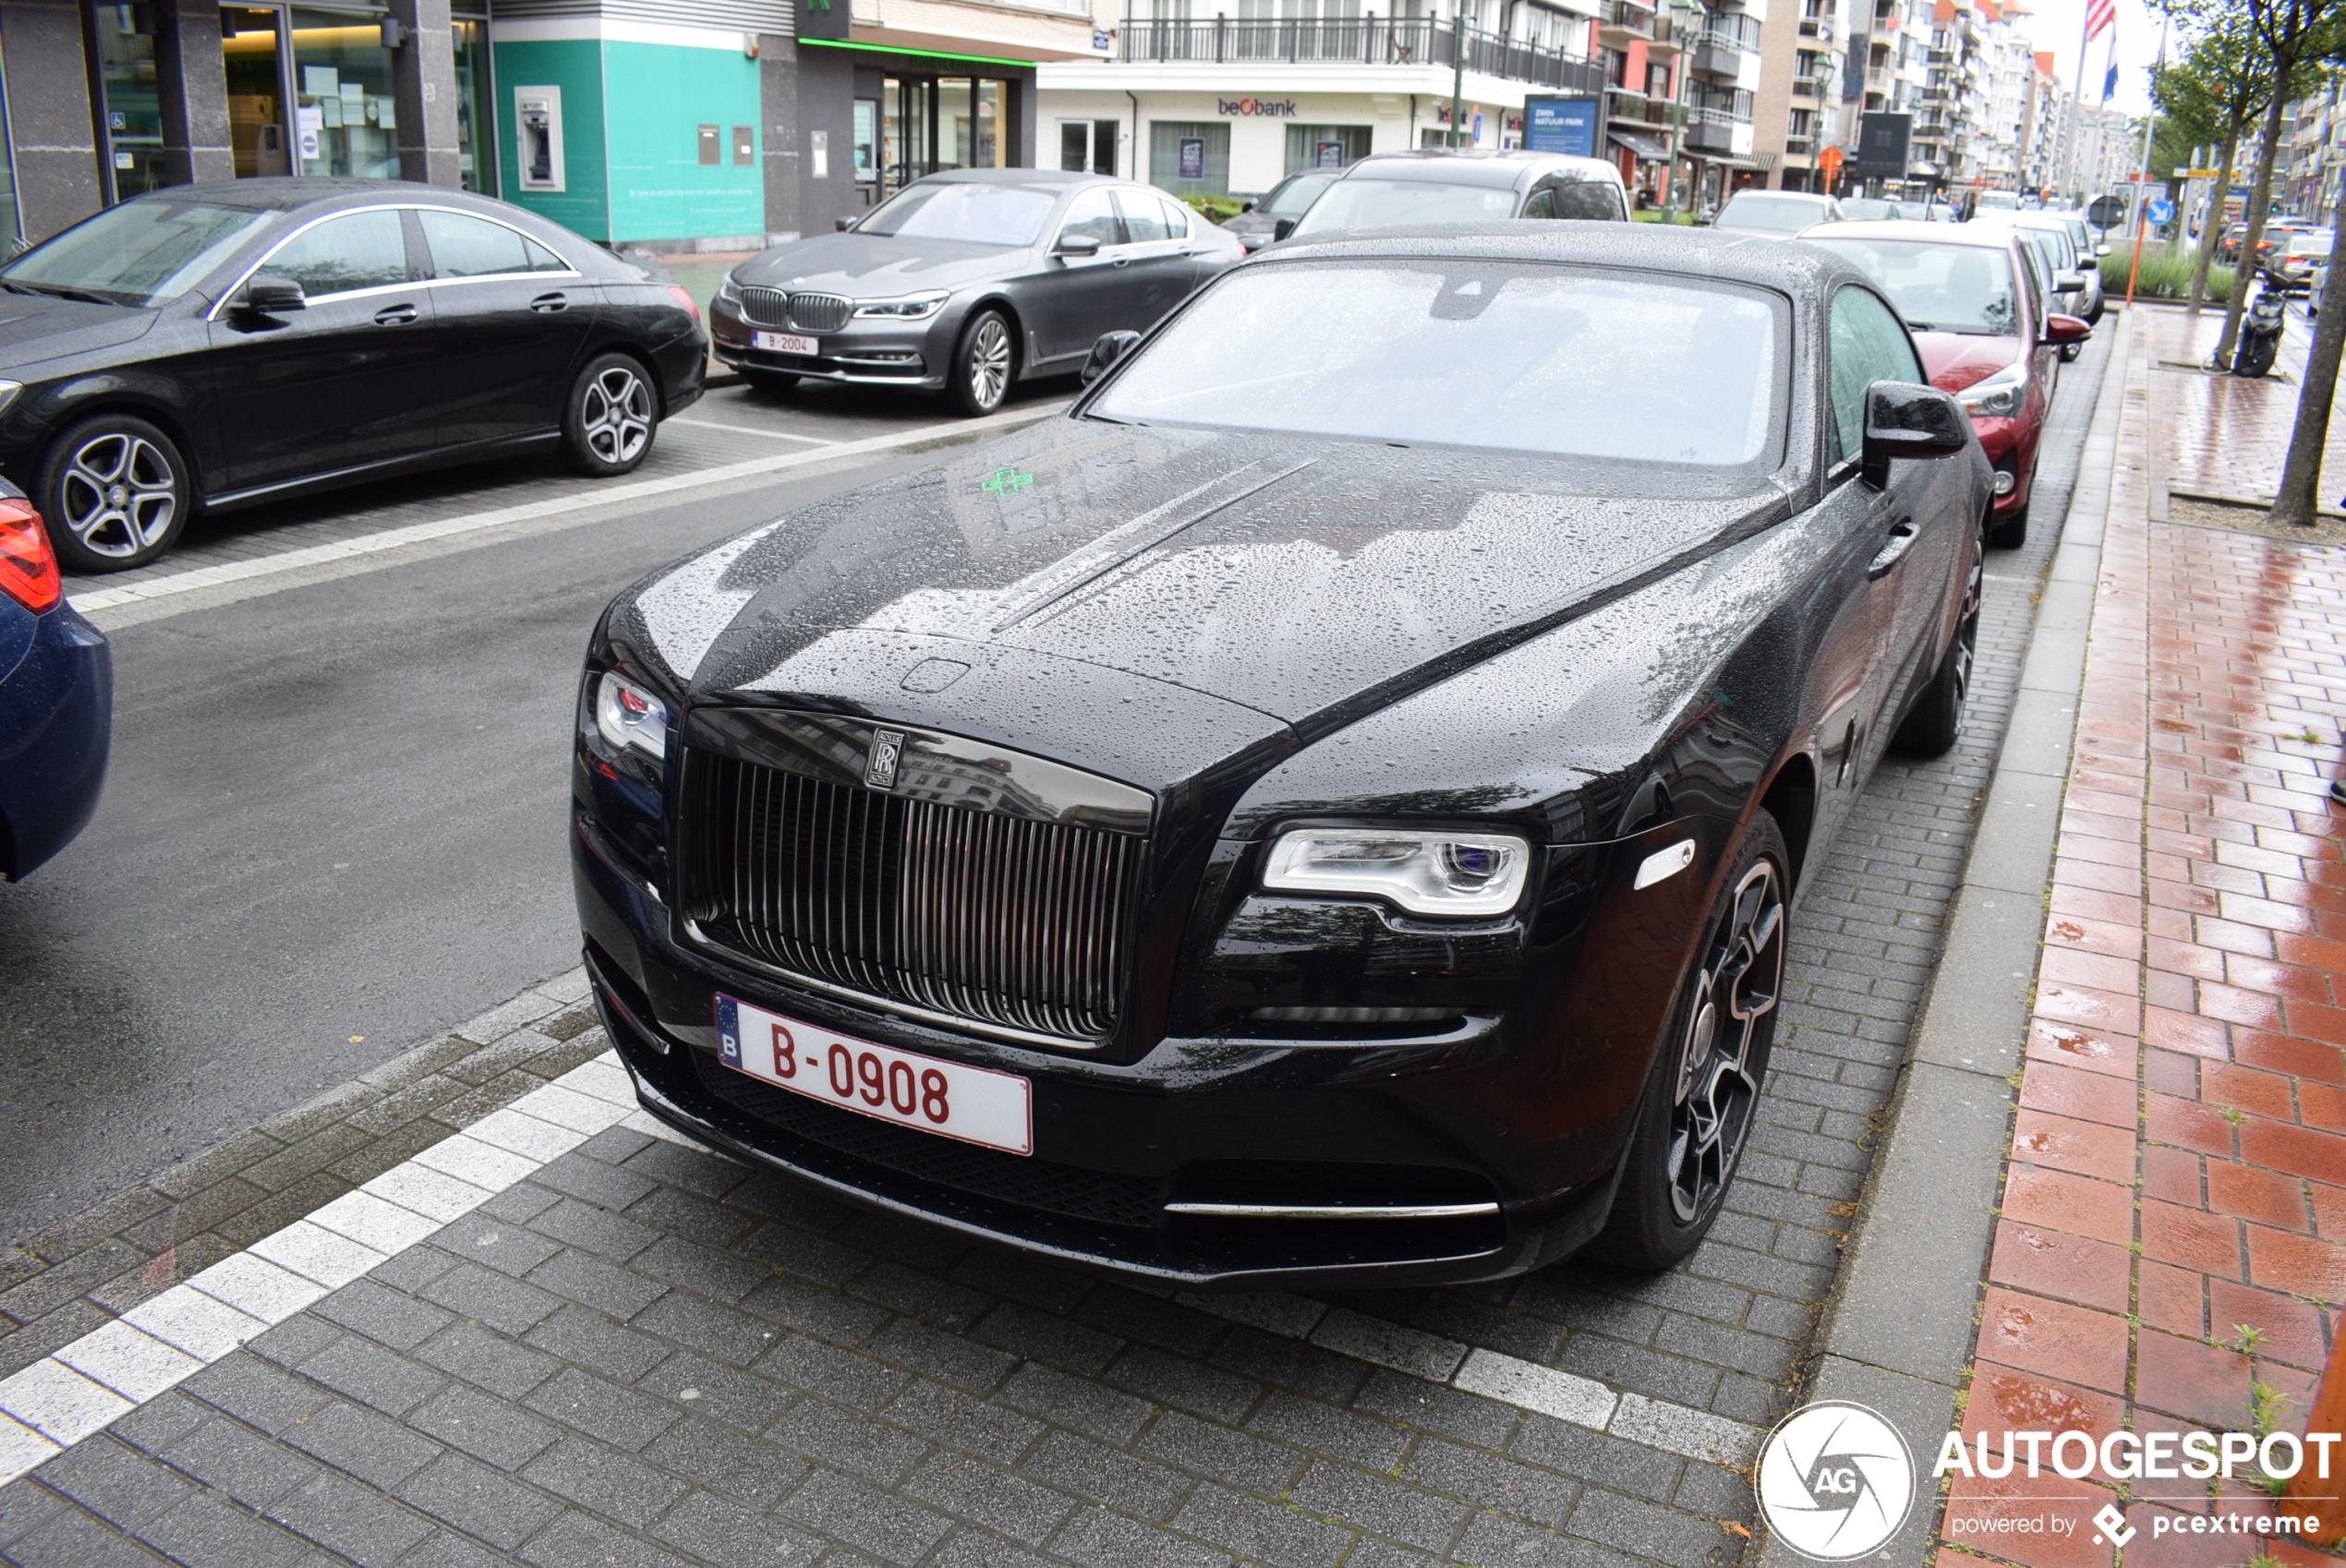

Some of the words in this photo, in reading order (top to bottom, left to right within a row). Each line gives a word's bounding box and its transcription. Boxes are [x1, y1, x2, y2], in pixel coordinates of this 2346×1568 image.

[1535, 109, 1554, 117] ZWIN
[1535, 117, 1564, 126] NATUUR
[880, 733, 901, 742] ROLLS
[722, 1035, 737, 1057] B
[771, 1023, 949, 1124] B-0908
